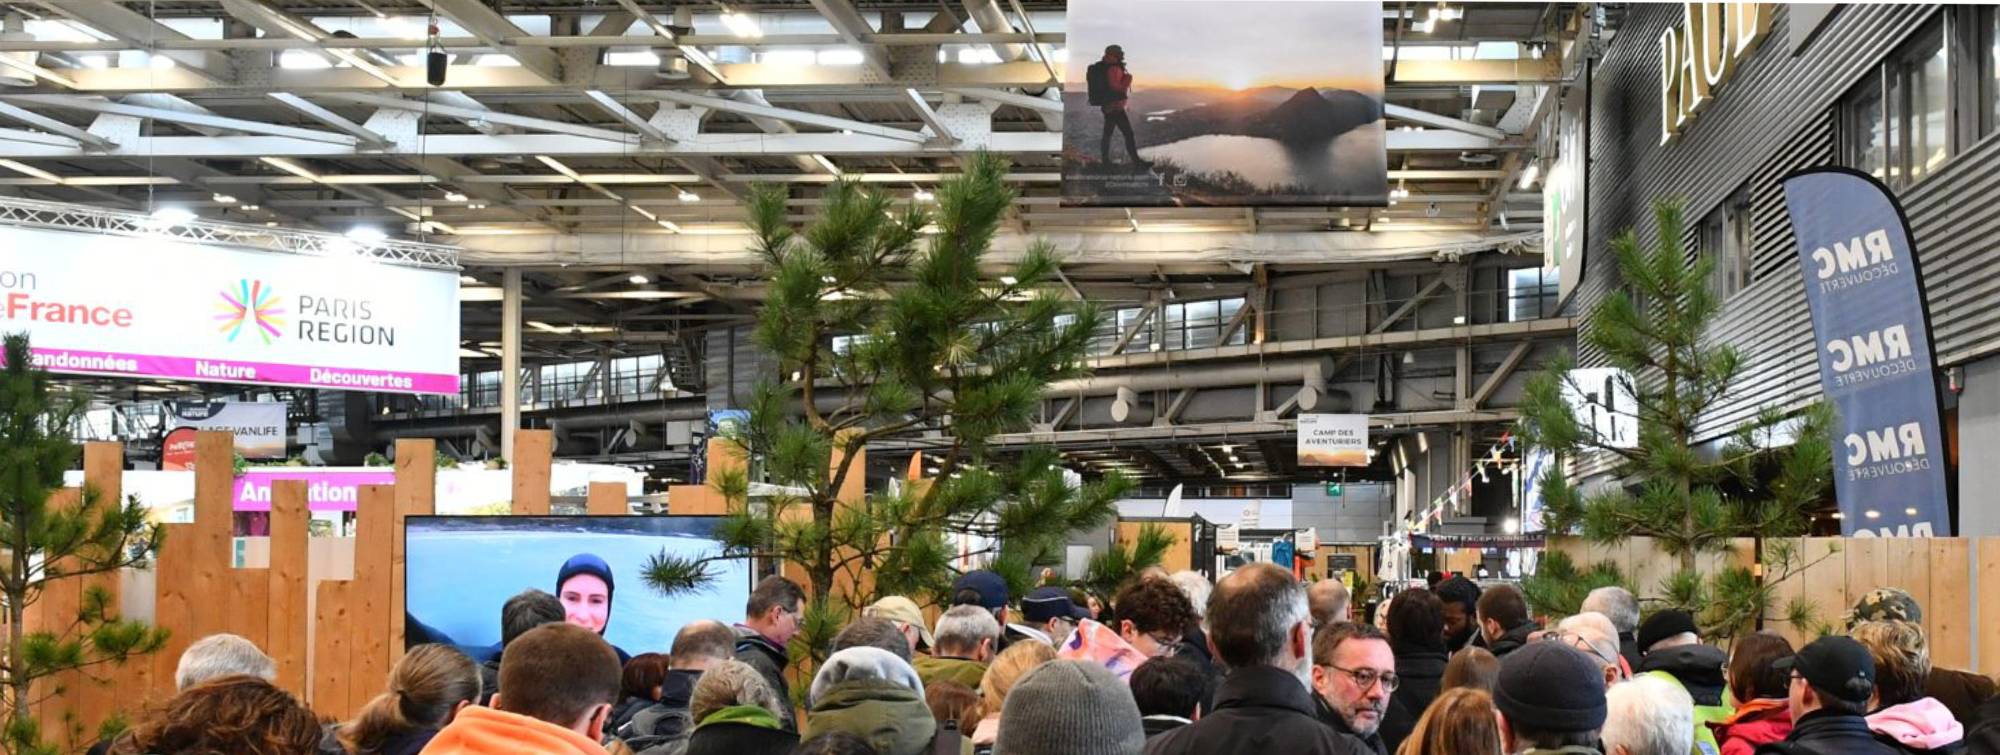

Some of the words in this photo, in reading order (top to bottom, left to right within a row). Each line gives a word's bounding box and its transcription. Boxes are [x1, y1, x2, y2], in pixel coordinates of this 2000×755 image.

[298, 295, 372, 320] PARIS
[298, 320, 395, 346] REGION
[27, 351, 138, 371] andonnées
[195, 360, 256, 379] Nature
[310, 367, 413, 389] Découvertes
[234, 426, 279, 437] VANLIFE
[240, 480, 357, 503] Antion
